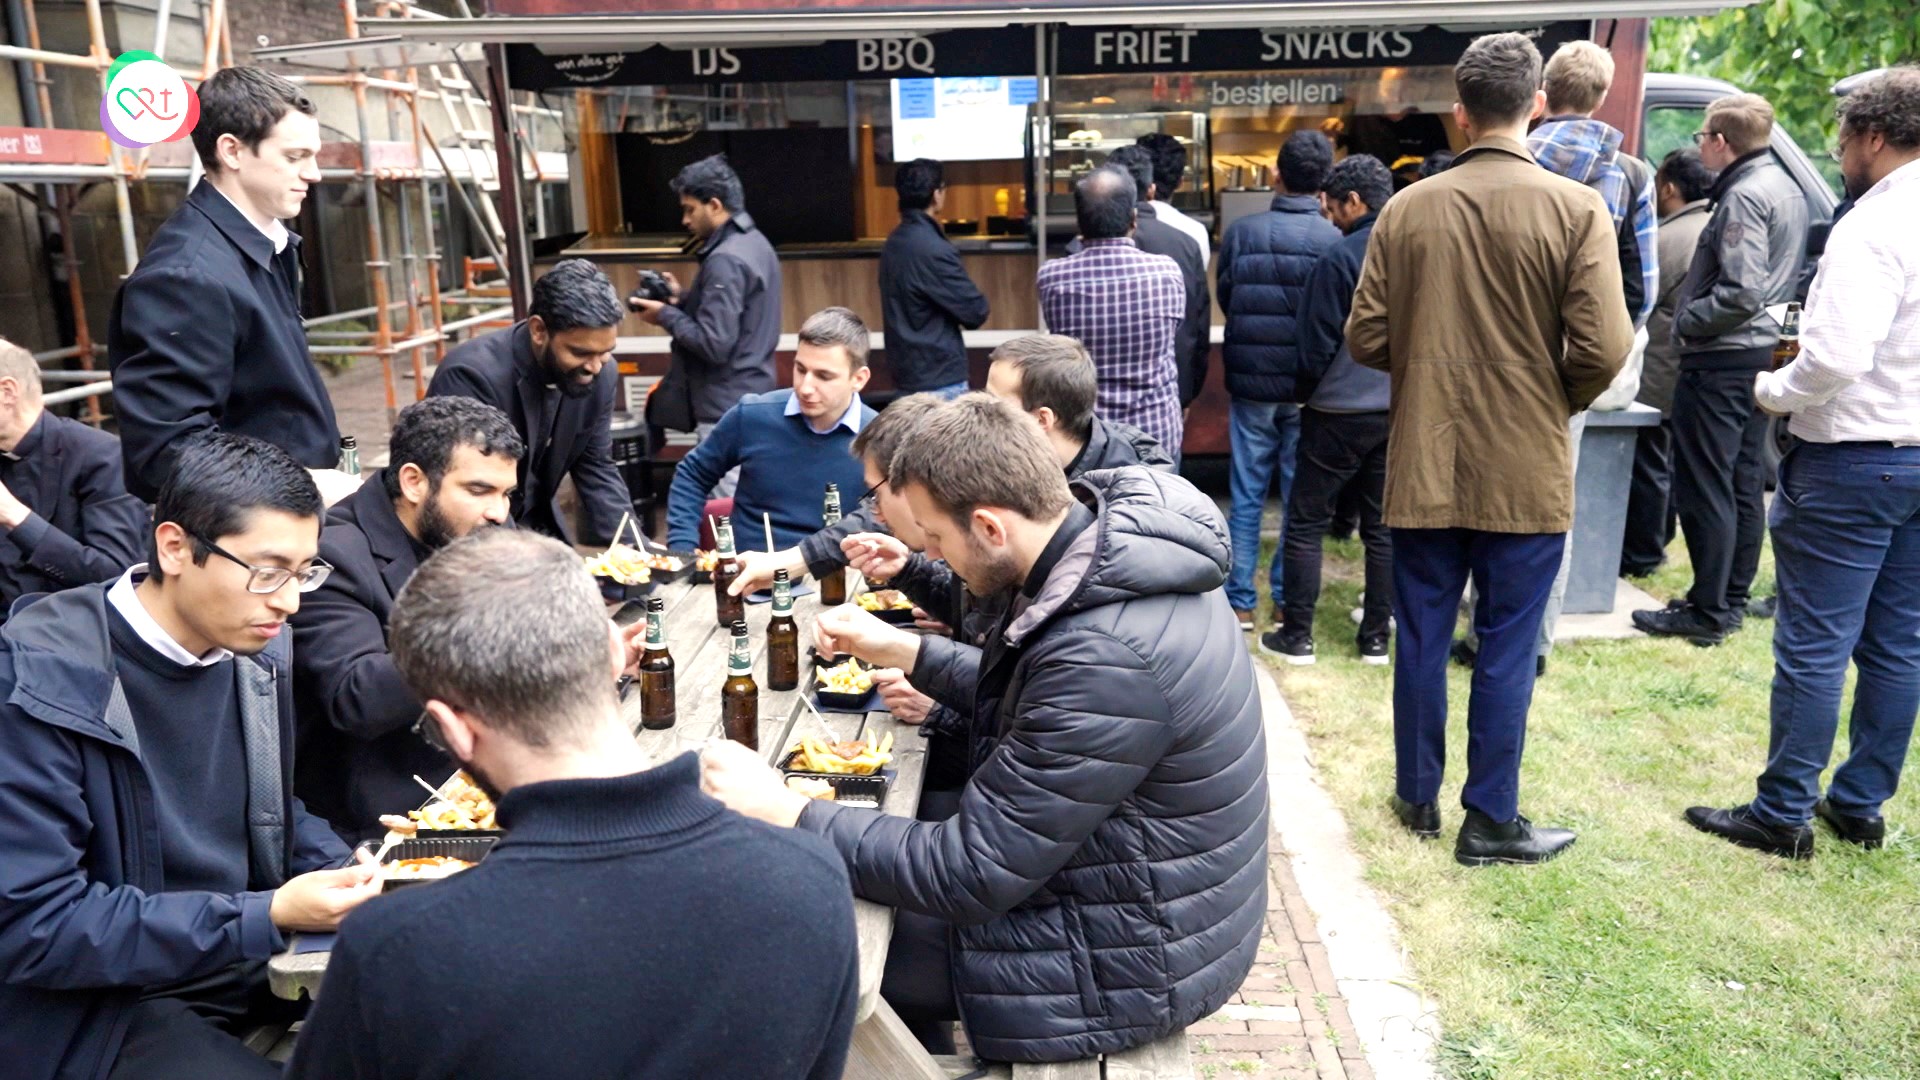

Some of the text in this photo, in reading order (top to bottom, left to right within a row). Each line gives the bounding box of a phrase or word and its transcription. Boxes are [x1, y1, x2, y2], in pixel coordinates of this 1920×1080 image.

[692, 47, 741, 76] IJS
[857, 37, 935, 74] BBQ
[1094, 30, 1198, 65] FRIET
[1260, 29, 1413, 62] SNACKS
[1211, 80, 1337, 105] bestellen
